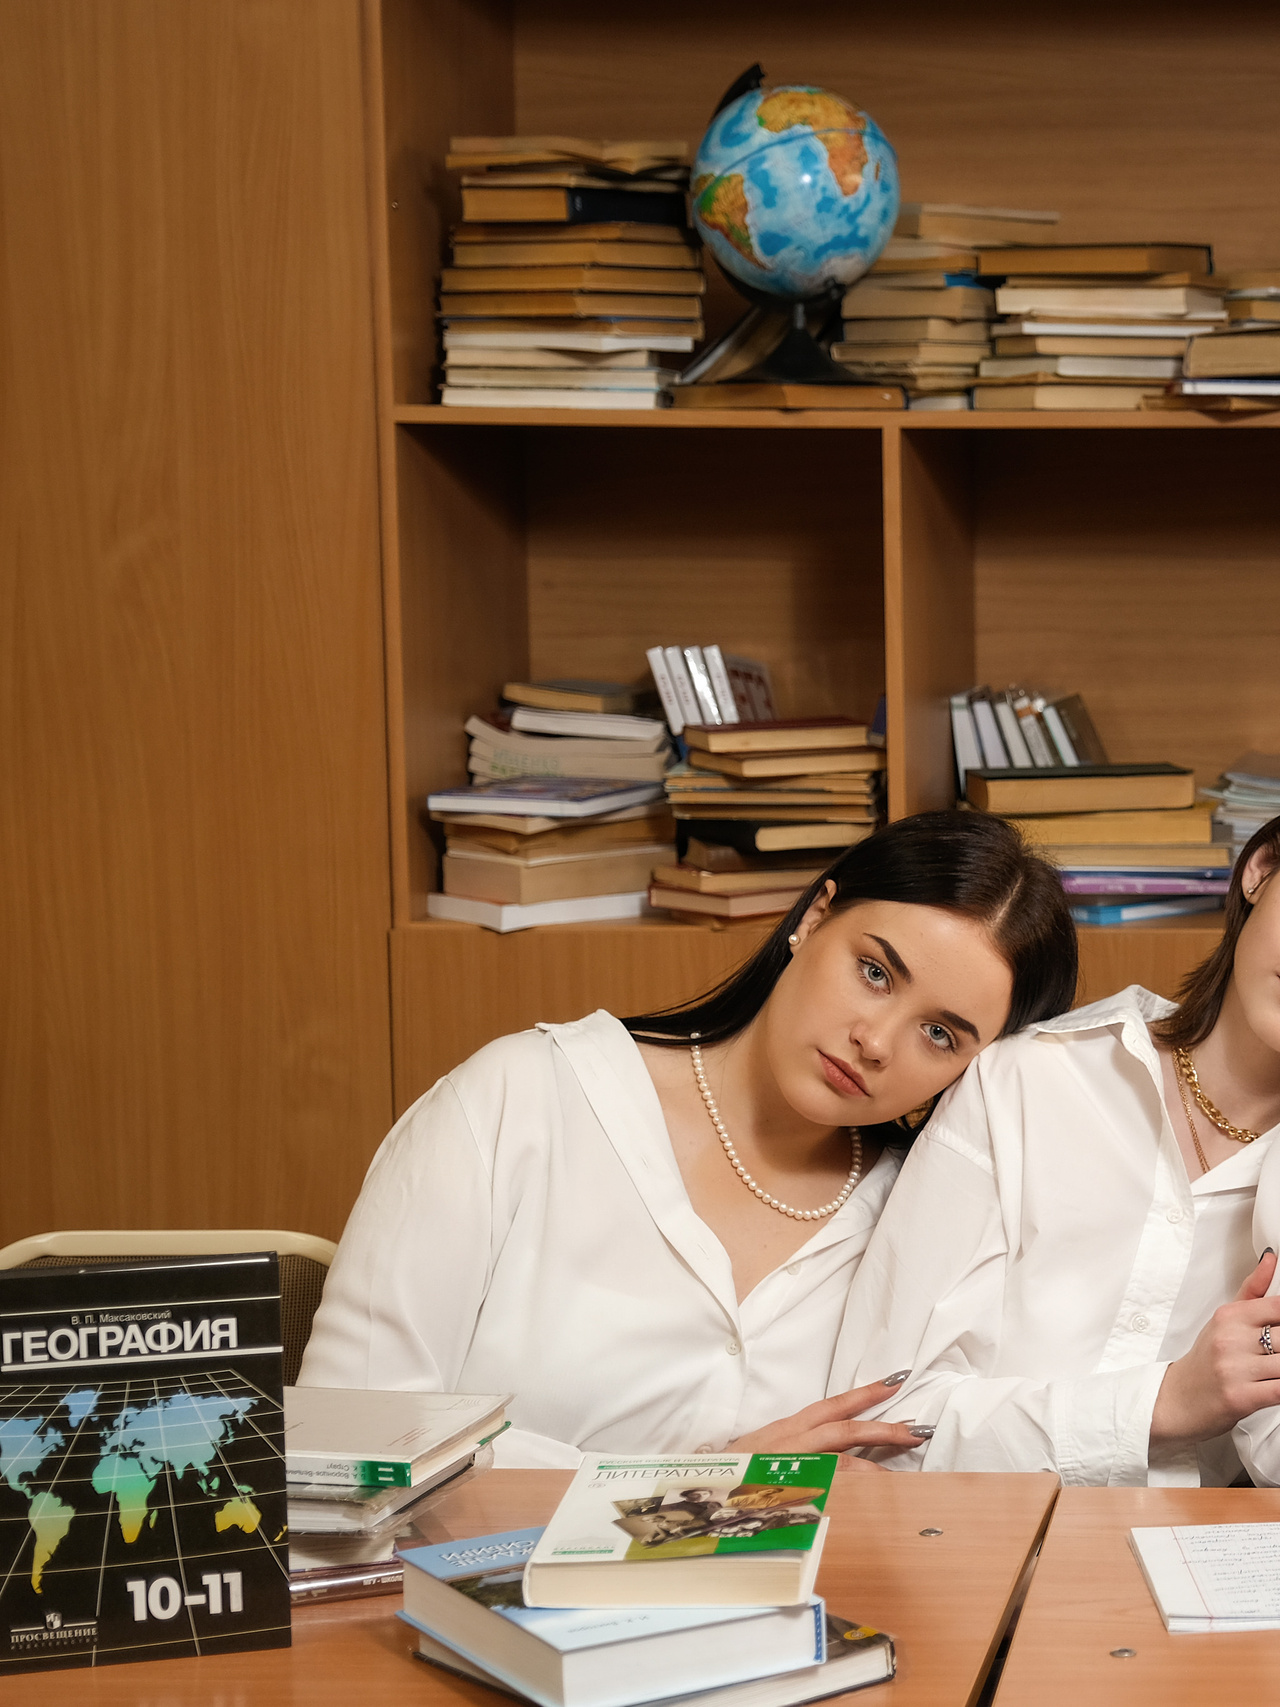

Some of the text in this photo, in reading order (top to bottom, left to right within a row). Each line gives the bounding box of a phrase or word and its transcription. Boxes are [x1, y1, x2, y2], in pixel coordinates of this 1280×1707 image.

[71, 1310, 172, 1326] В. П. Максаковский
[2, 1317, 238, 1364] ГЕОГРАФИЯ
[594, 1468, 735, 1481] ЛИТЕРАТУРА
[769, 1461, 801, 1471] 11
[439, 1540, 535, 1561] СИБИРИ
[126, 1571, 243, 1622] 10-11
[10, 1627, 98, 1644] ПРОСВЕЩЕНИЕ
